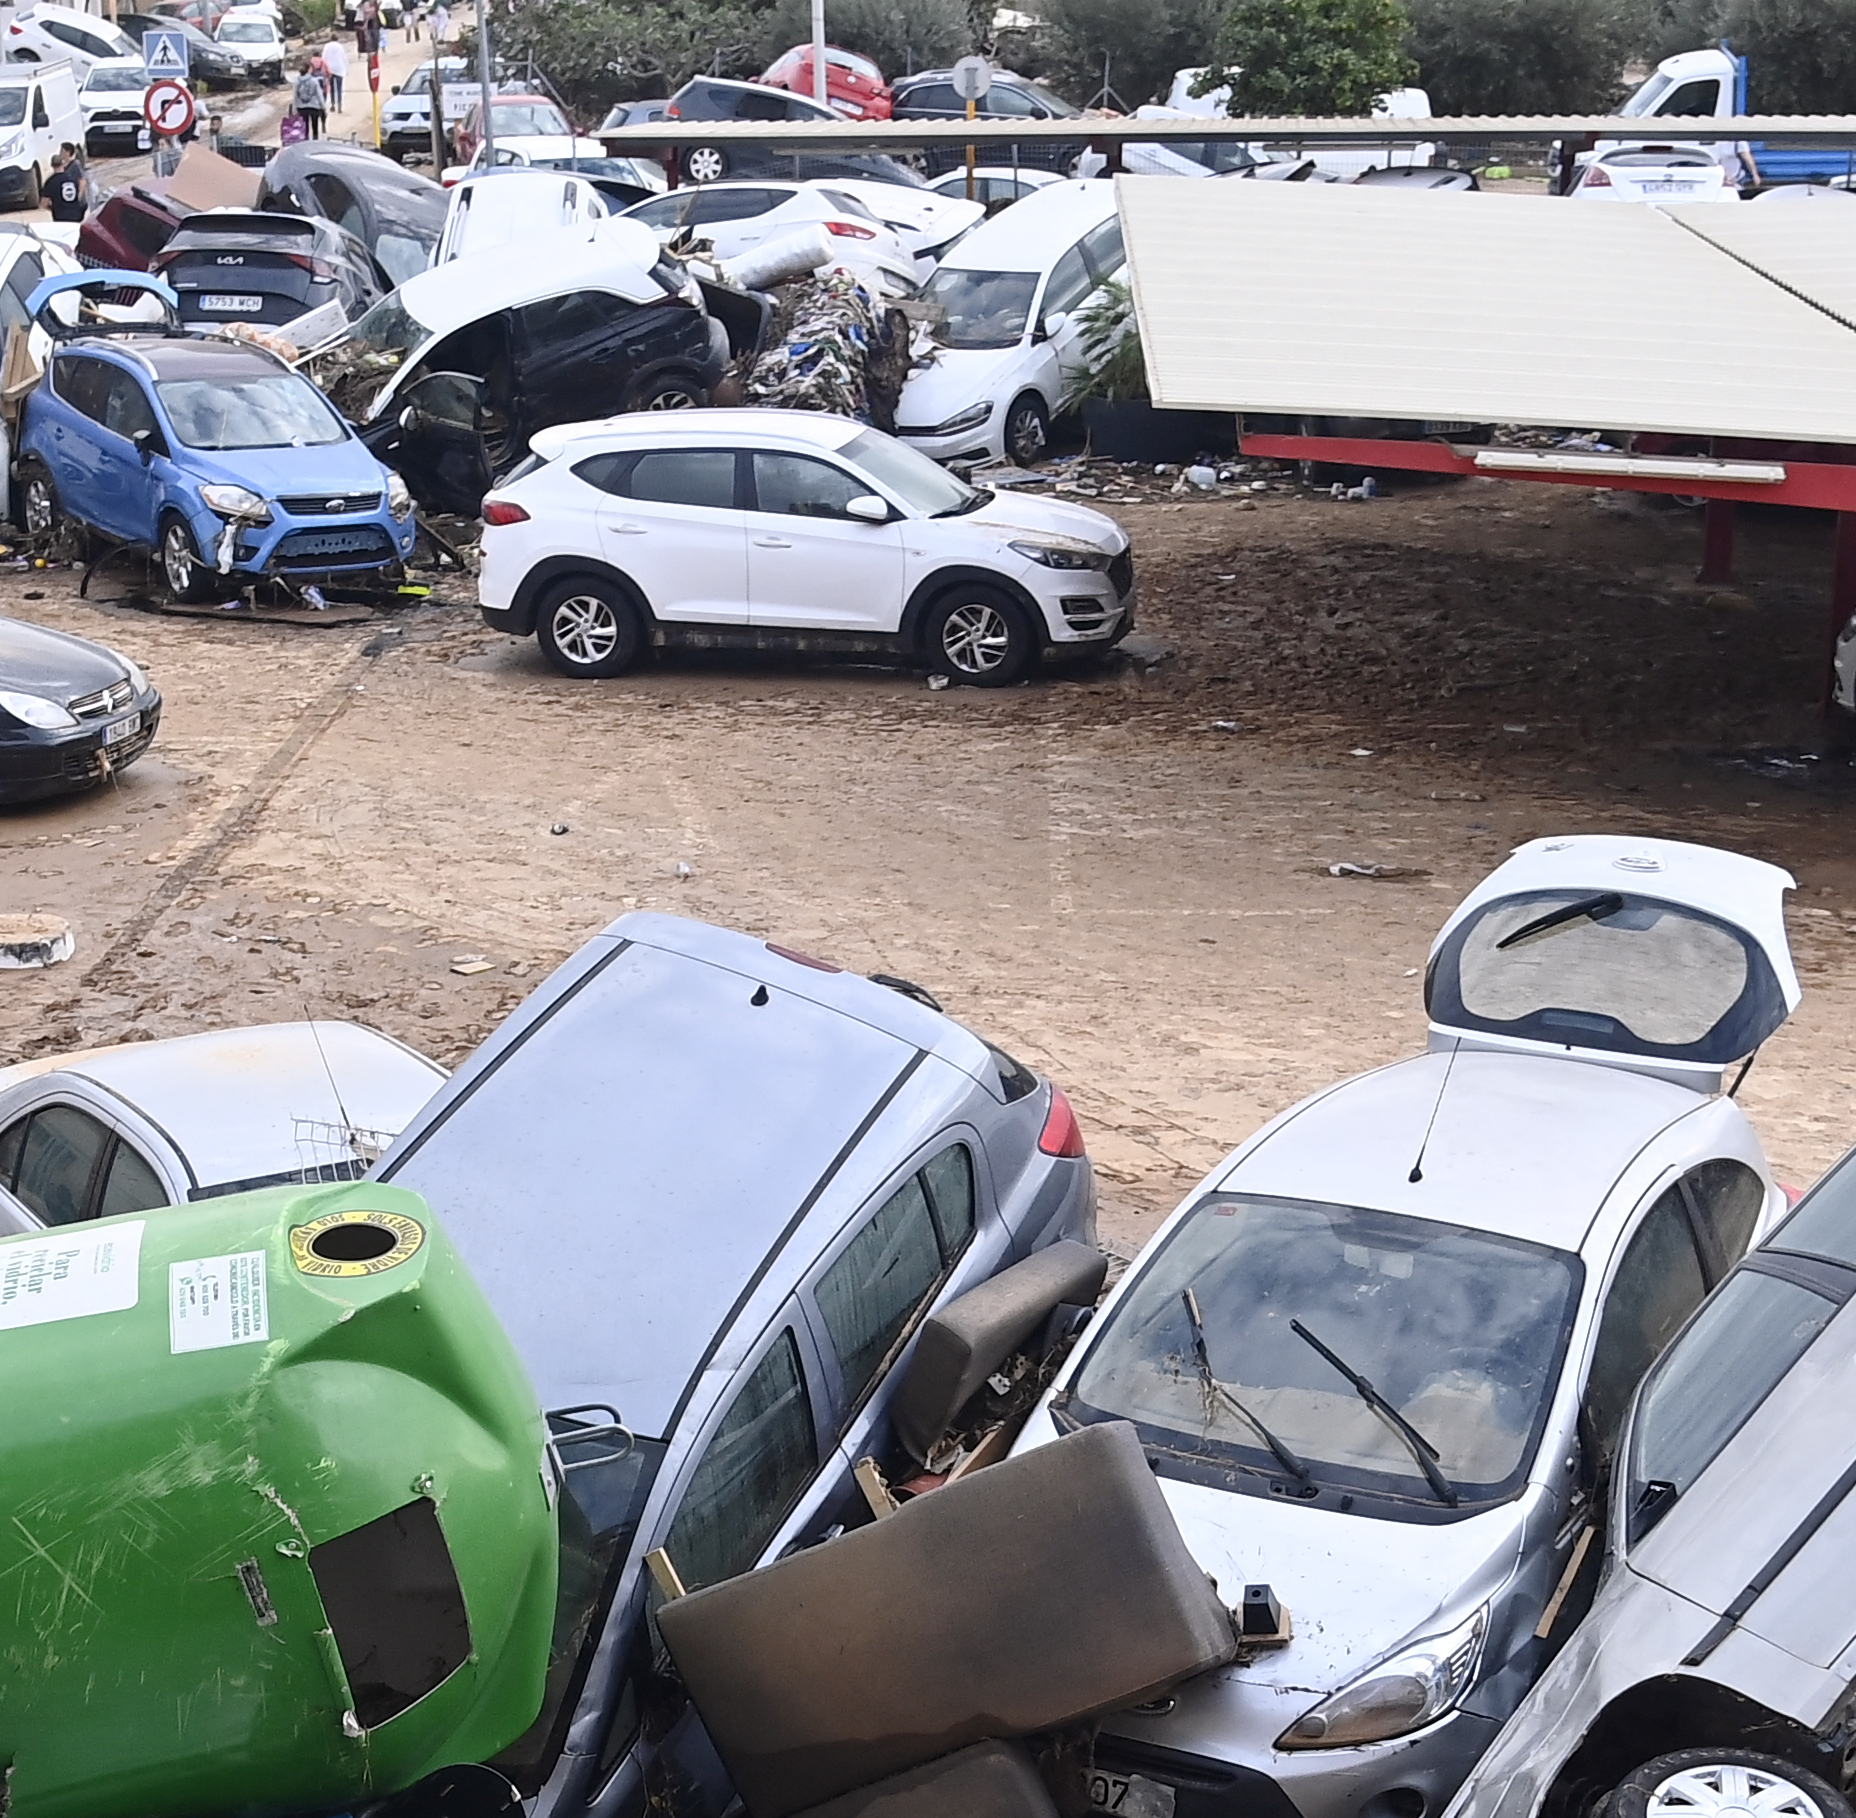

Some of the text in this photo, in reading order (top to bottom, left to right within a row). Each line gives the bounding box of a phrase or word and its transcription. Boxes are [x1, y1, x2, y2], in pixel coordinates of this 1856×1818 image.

[363, 1213, 395, 1225] SOLS
[28, 1249, 53, 1294] reciclar
[53, 1249, 81, 1280] Para
[302, 1260, 343, 1275] VIDRIO
[1089, 1775, 1130, 1810] 07
